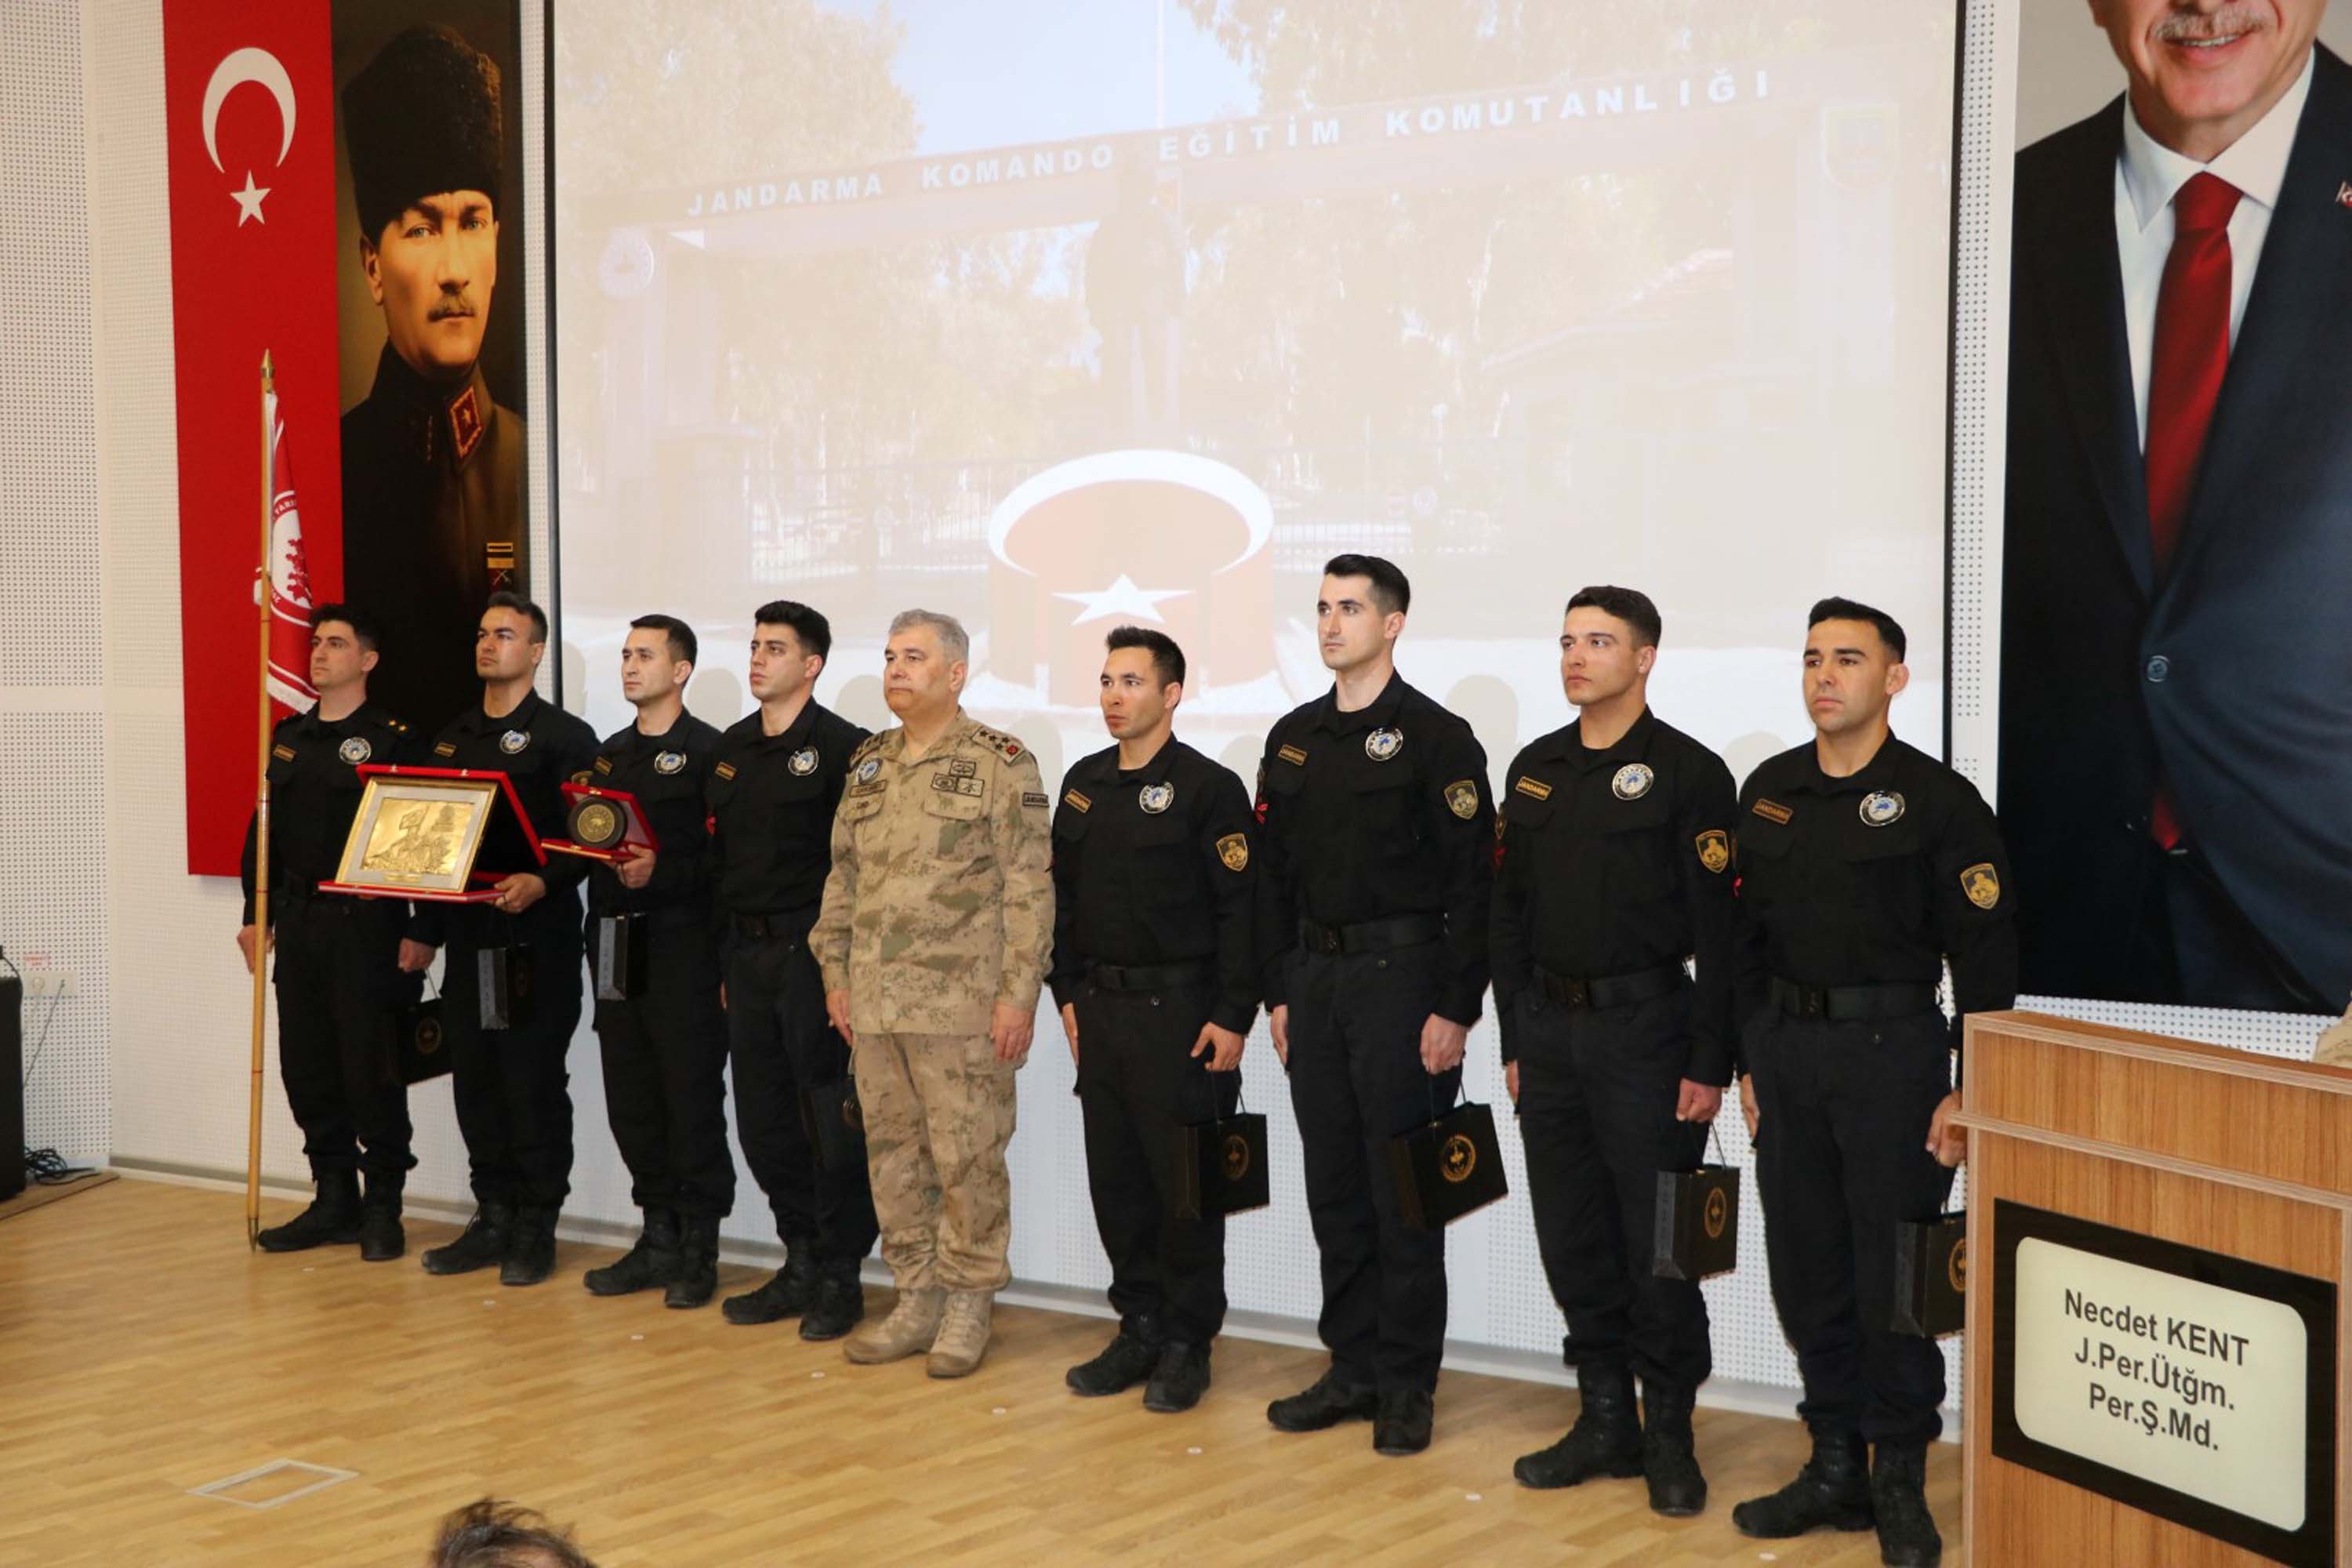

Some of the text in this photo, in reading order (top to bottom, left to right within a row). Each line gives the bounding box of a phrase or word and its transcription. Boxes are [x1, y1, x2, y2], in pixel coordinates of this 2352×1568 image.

[688, 69, 1769, 217] JANDARMA KOMANDO EĞİTİM KOMUTANLIĞI
[2065, 1289, 2249, 1367] Necdet KENT
[2075, 1338, 2236, 1410] J.Per.Ütğm.
[2089, 1382, 2220, 1450] Per.Ş.Md.
